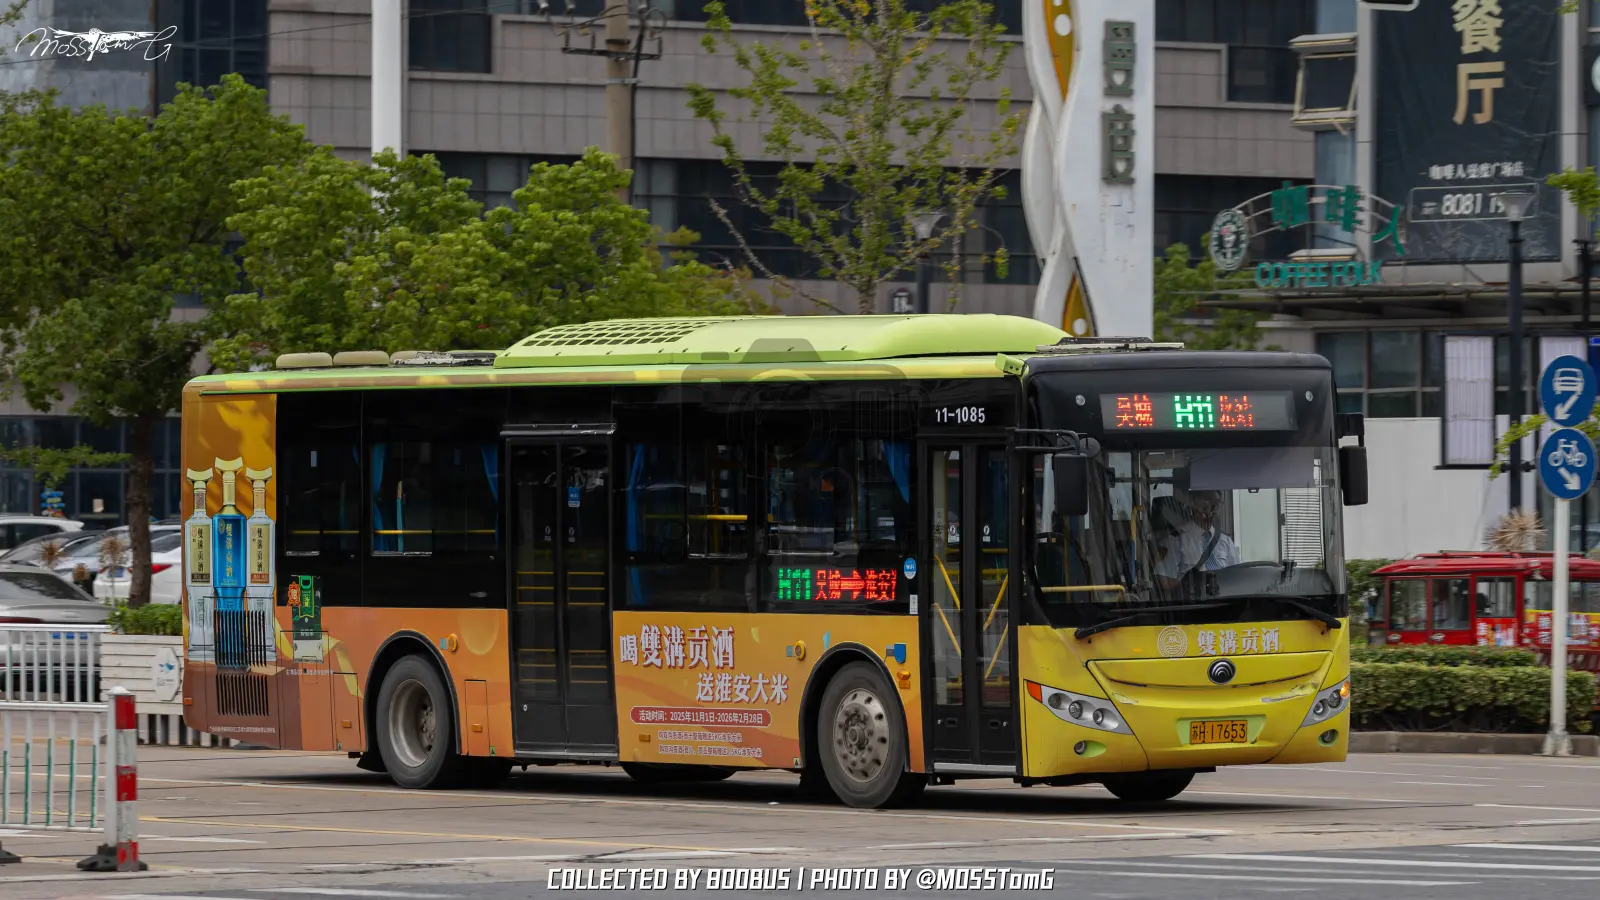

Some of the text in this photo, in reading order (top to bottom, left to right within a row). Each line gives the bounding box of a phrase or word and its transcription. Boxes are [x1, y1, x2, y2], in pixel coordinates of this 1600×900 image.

[1271, 180, 1405, 257] 咖啡人
[1256, 259, 1383, 288] COFFEE FOLK
[935, 406, 986, 424] 11-1085
[1174, 395, 1215, 428] H11
[695, 672, 789, 704] 送淮安大米
